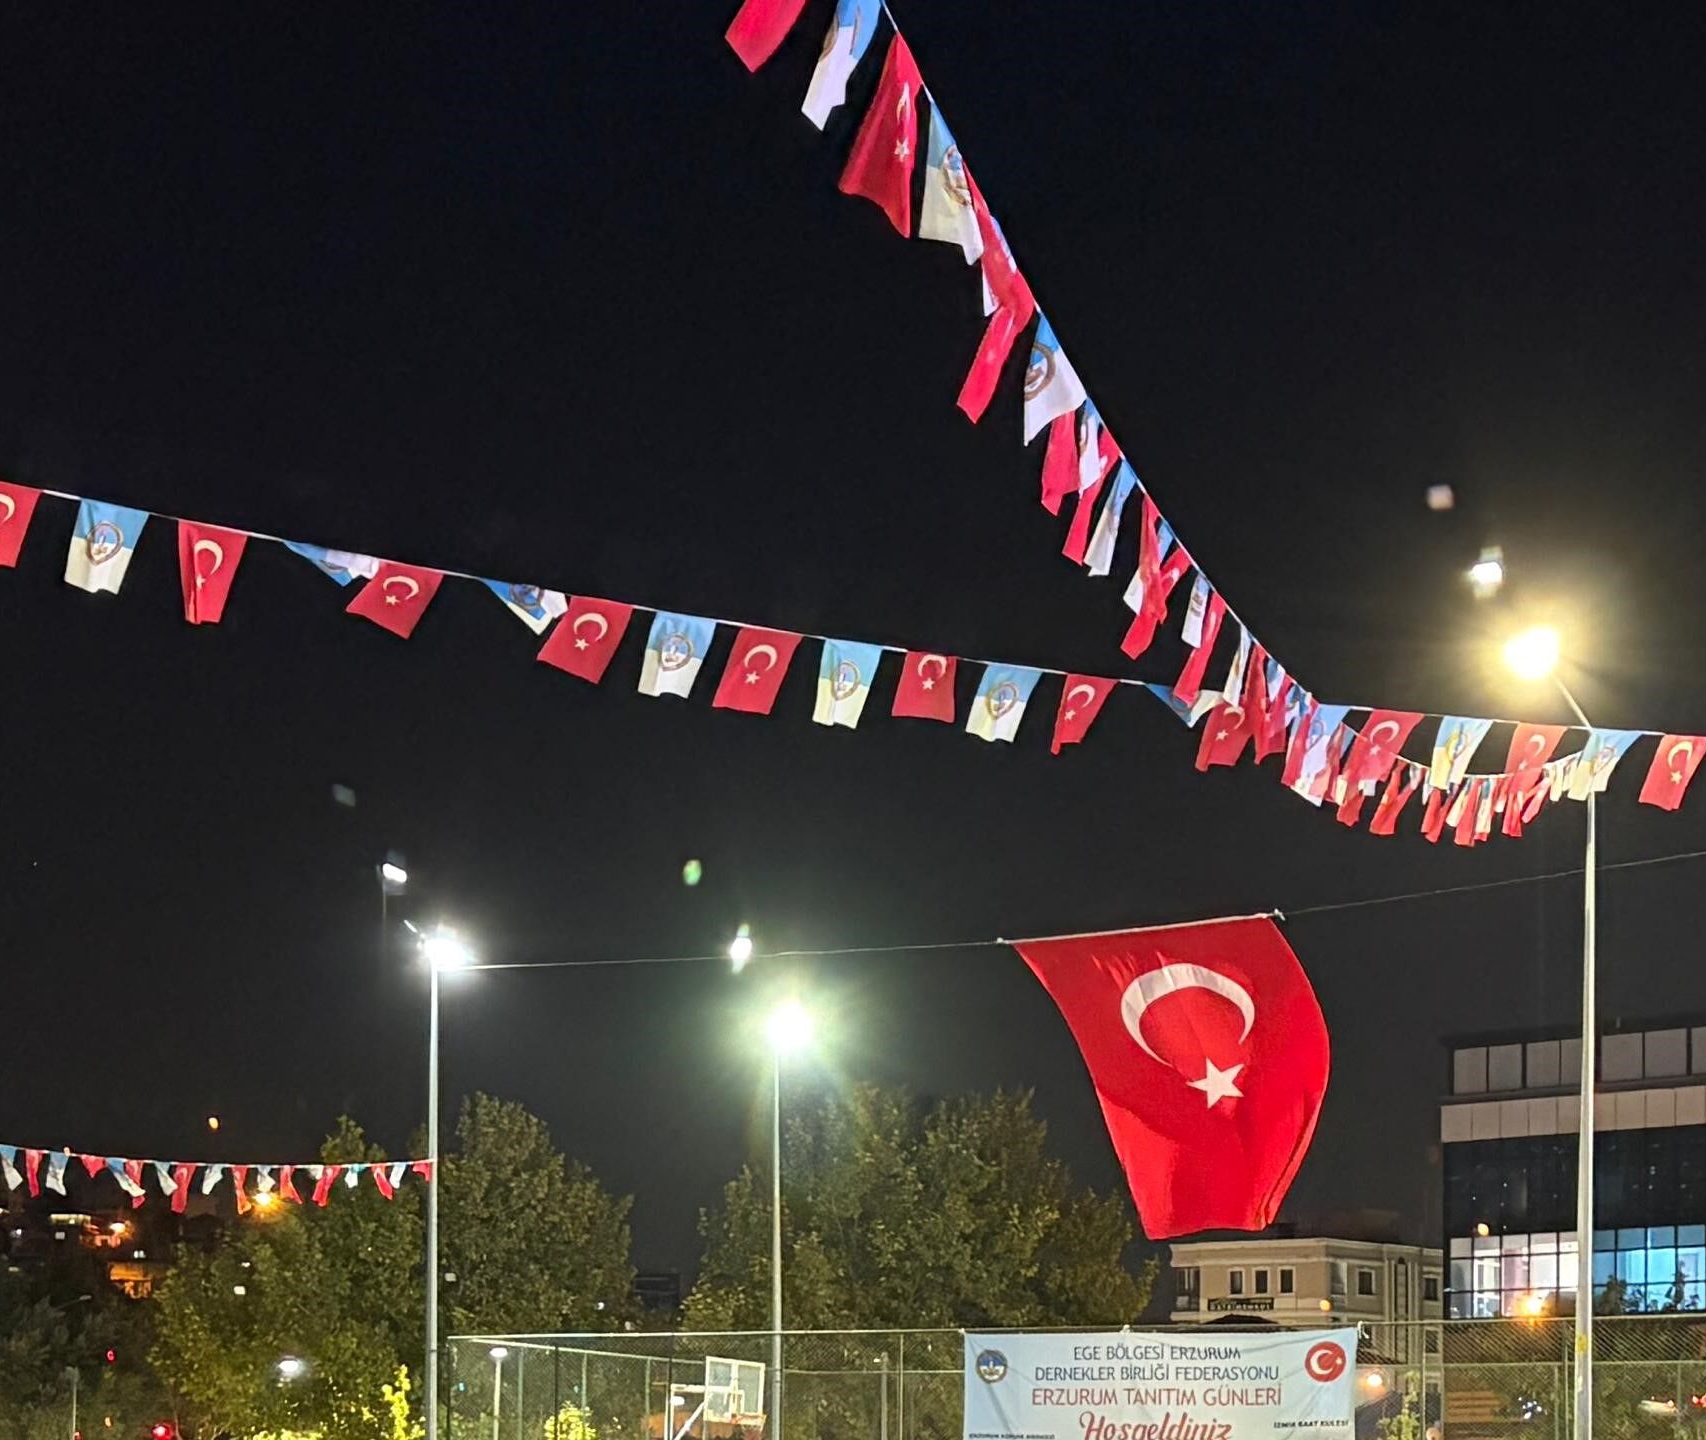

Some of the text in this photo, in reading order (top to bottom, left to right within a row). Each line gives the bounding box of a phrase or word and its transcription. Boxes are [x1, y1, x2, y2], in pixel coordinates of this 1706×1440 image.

[1073, 1342, 1242, 1361] EGE BÖLGESİ ERZURUM
[1034, 1362, 1280, 1381] DERNEKLER BİRLİĞİ FEDERASYONU
[1031, 1382, 1282, 1406] ERZURUM TANITIM GÜNLERİ
